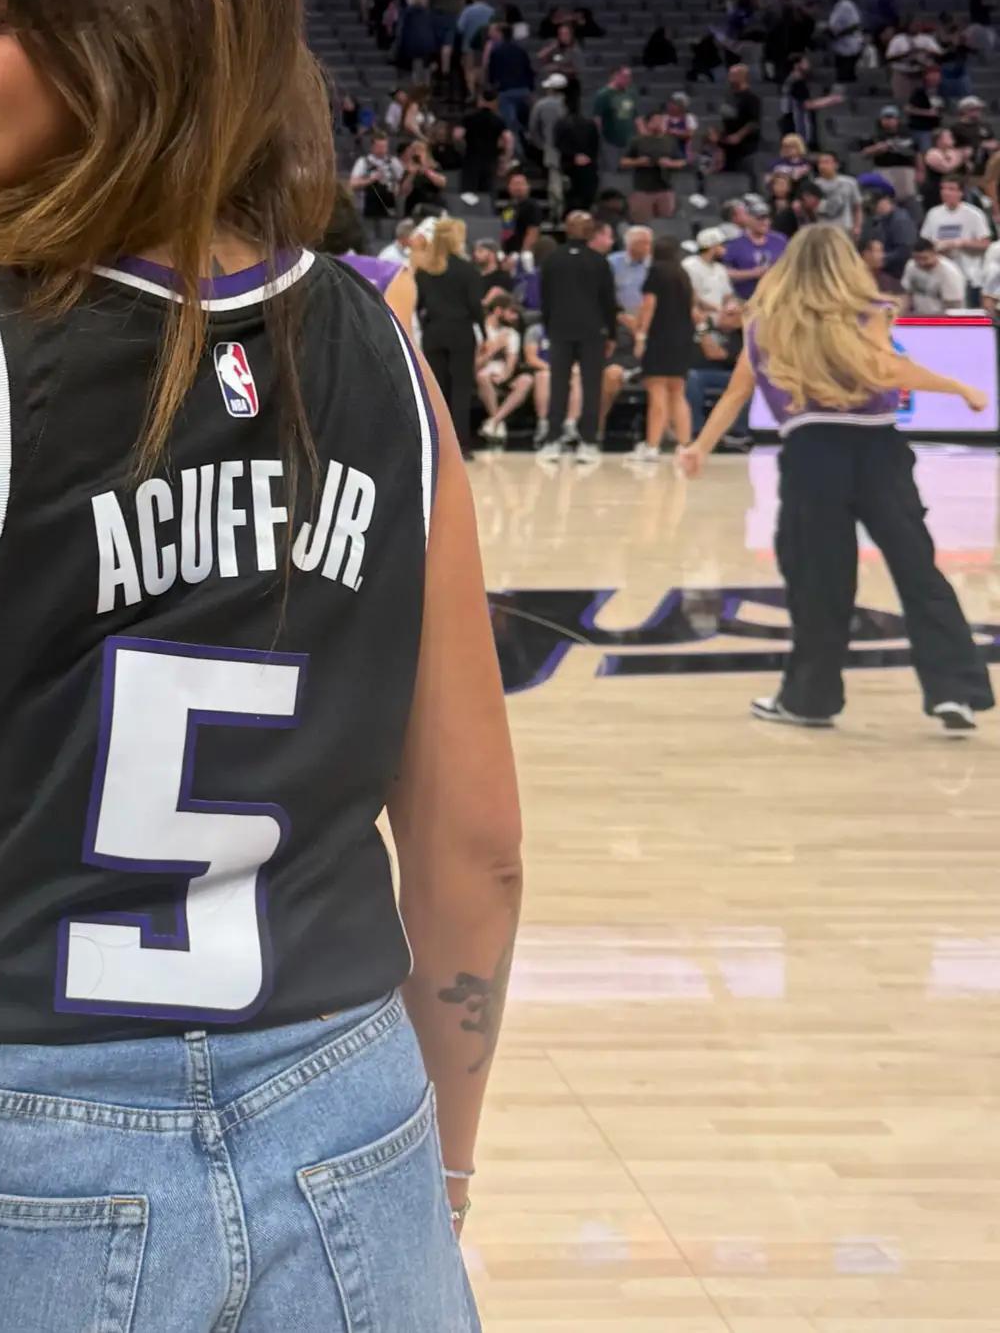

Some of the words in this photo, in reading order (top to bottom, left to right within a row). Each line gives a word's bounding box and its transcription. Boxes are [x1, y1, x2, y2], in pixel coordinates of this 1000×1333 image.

[91, 459, 289, 615] ACUFF
[291, 459, 377, 593] JR.
[54, 635, 310, 1023] 5
